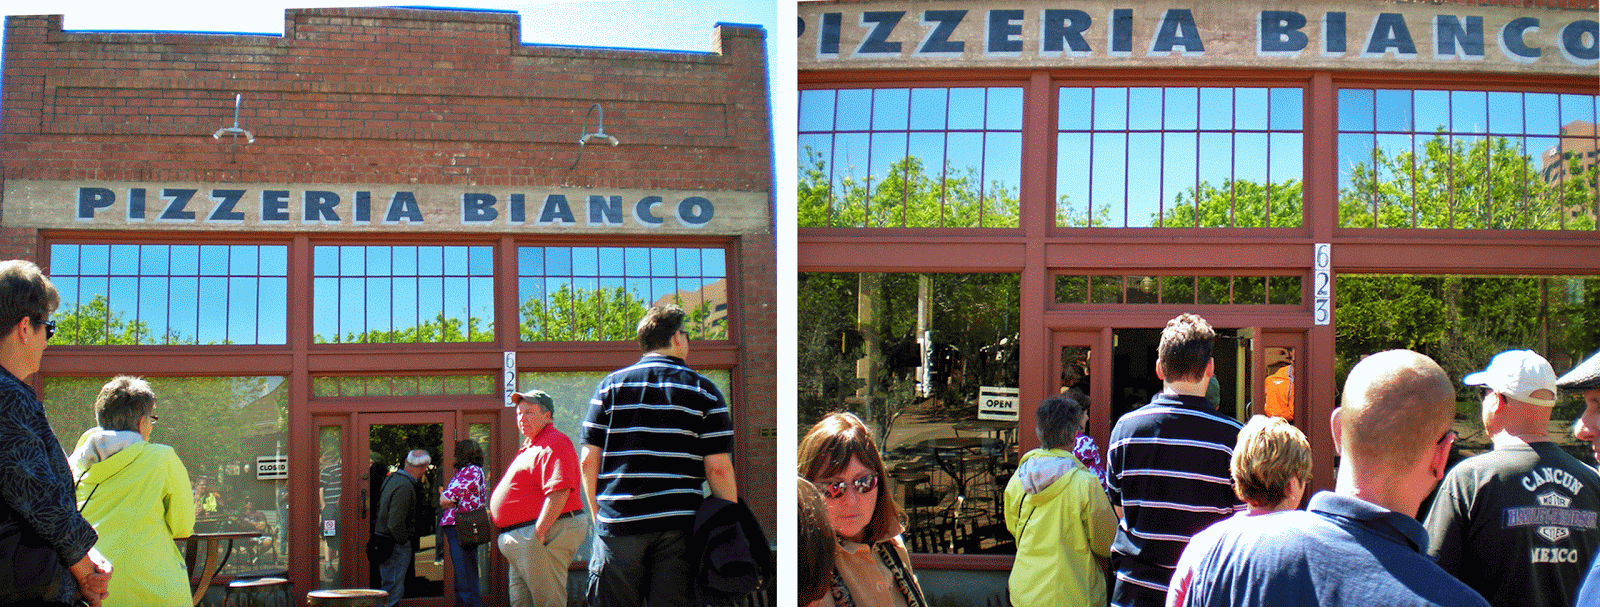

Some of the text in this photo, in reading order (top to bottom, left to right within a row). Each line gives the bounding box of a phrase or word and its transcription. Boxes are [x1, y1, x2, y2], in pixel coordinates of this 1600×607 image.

[797, 8, 1599, 66] IZZERIA BIANCO
[75, 187, 715, 228] PIZZERIA BIANCO
[1316, 244, 1330, 323] 623
[505, 352, 515, 406] 623
[986, 399, 1012, 409] OPEN
[259, 464, 286, 472] CLOSD
[1522, 467, 1584, 496] CANCUN
[1531, 547, 1578, 564] MEXCO
